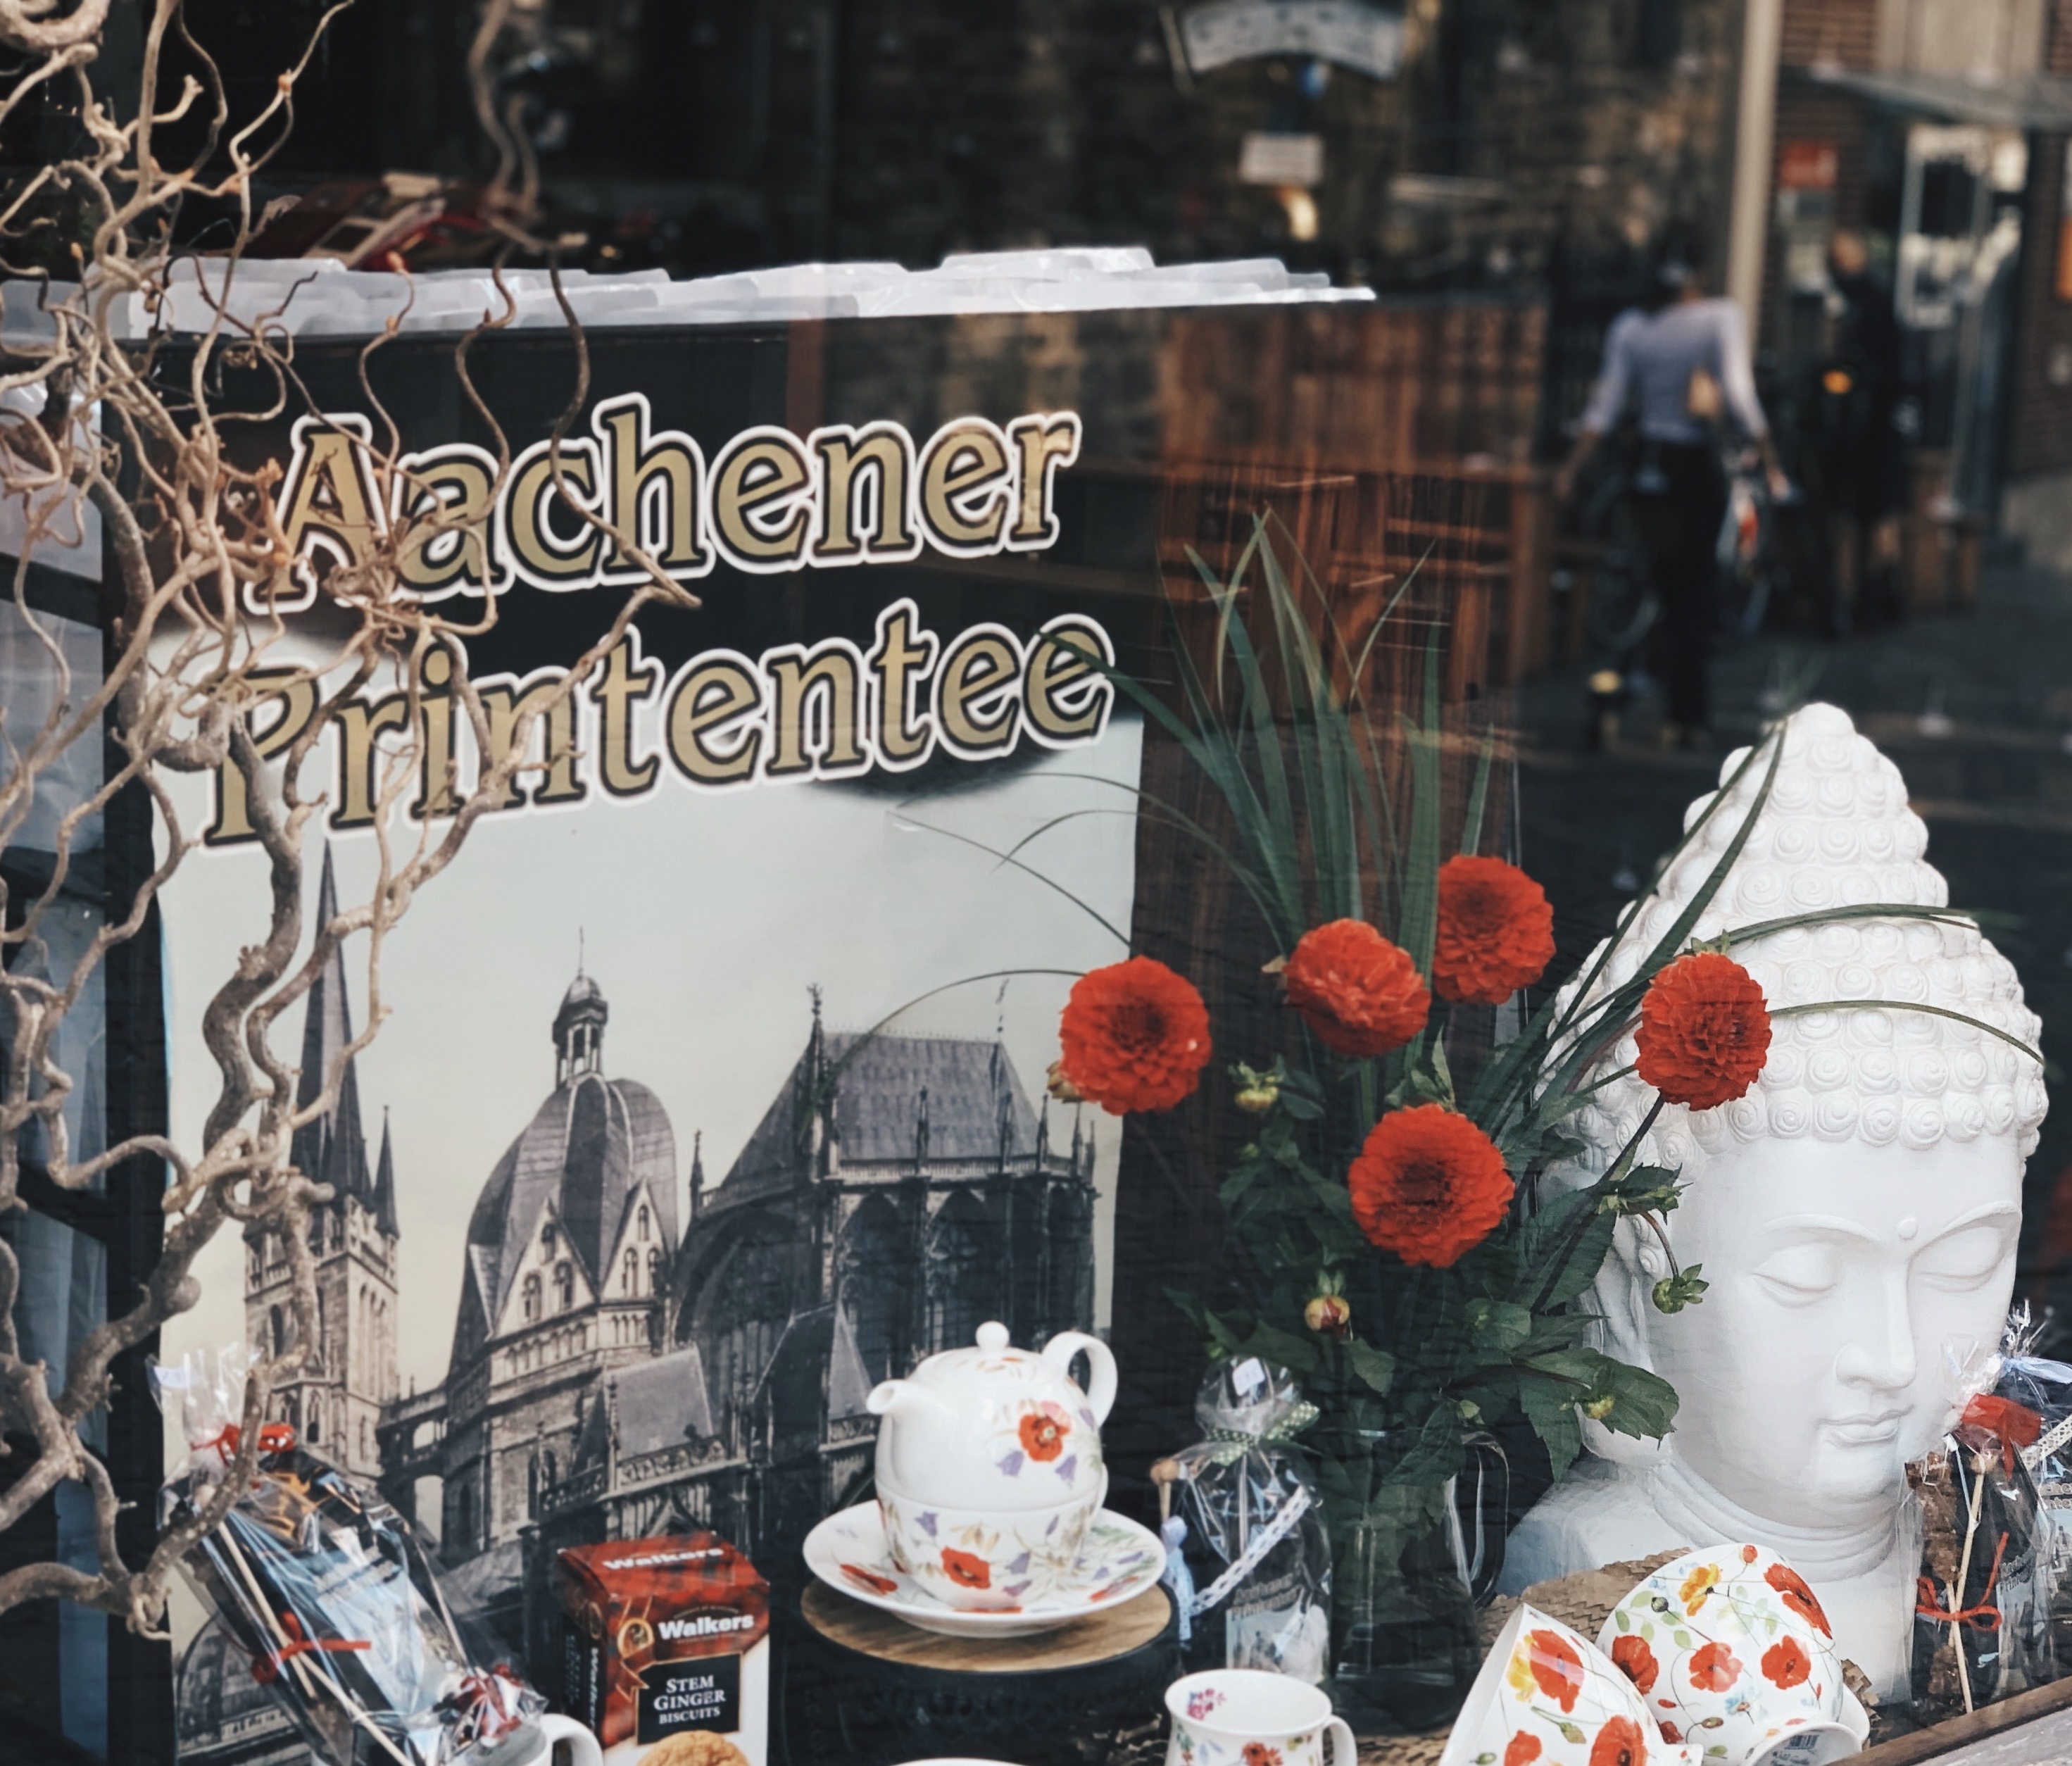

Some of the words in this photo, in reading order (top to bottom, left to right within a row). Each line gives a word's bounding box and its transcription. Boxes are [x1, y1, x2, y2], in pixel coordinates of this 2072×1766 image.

[245, 394, 1081, 614] Aachener
[199, 599, 1114, 851] Printentee
[602, 1548, 724, 1570] Walkers
[658, 1614, 754, 1640] Walkers
[666, 1675, 714, 1693] STEM
[653, 1689, 727, 1711] GINGER
[659, 1707, 720, 1724] BISCUITS
